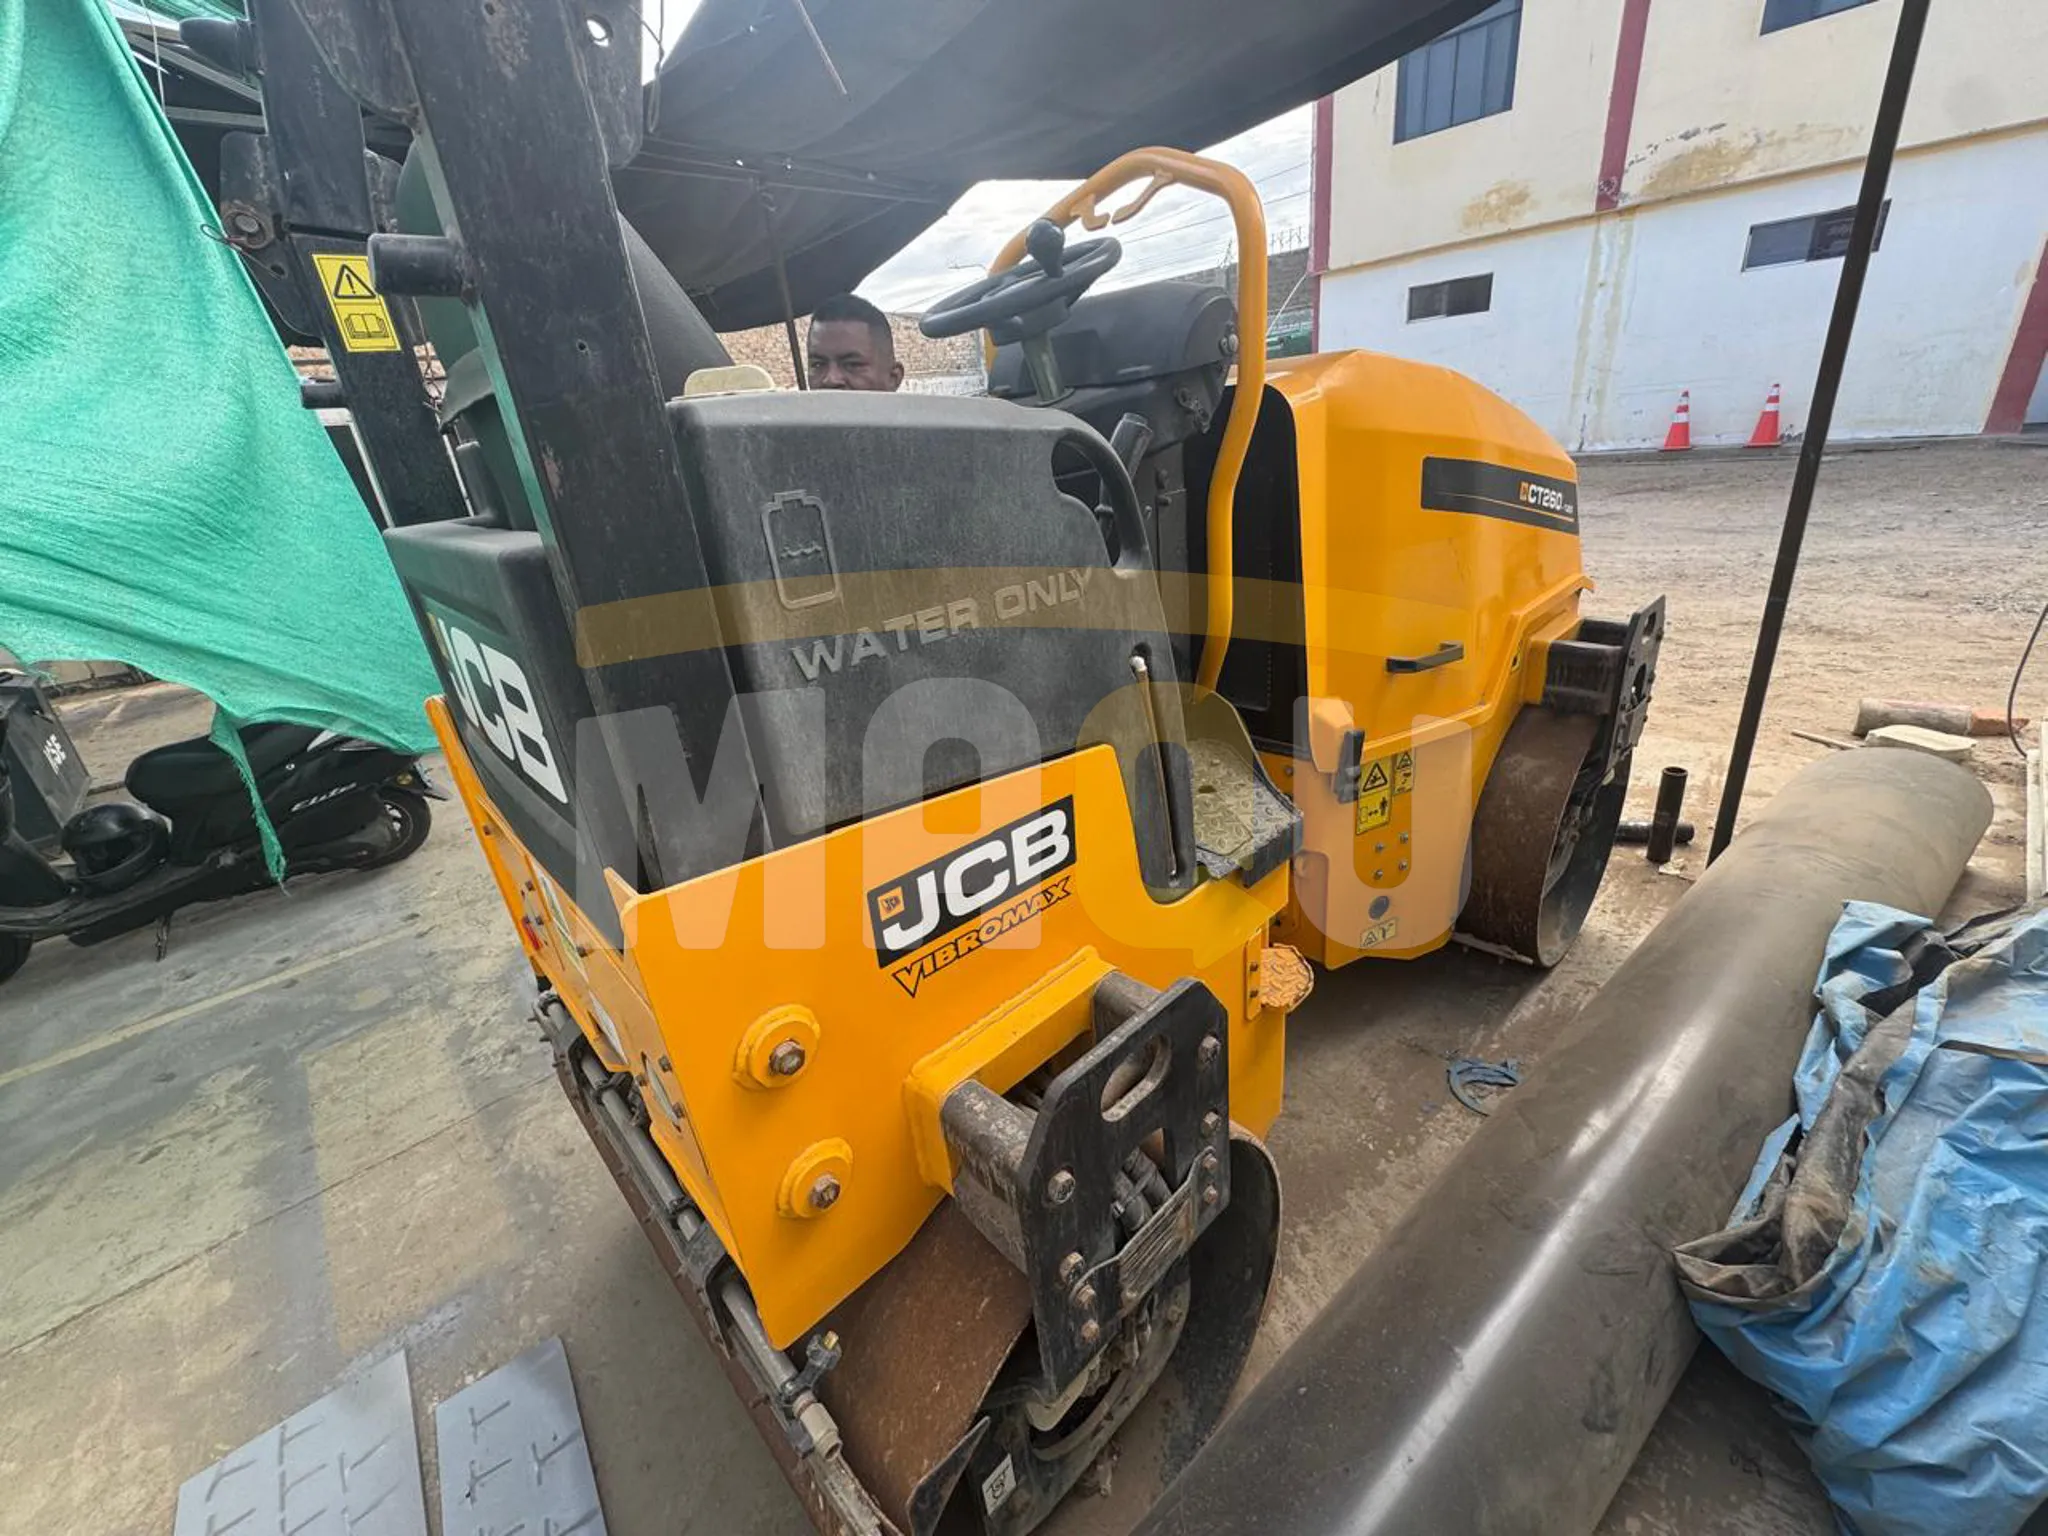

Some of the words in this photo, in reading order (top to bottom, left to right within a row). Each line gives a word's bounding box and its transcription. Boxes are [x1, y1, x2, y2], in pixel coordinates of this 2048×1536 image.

[1528, 484, 1563, 510] CT260
[792, 598, 979, 681] WATER
[994, 566, 1092, 621] ONLY
[437, 617, 568, 804] JCB
[882, 809, 1070, 951] JCB
[891, 875, 1072, 998] VIBROMAX
